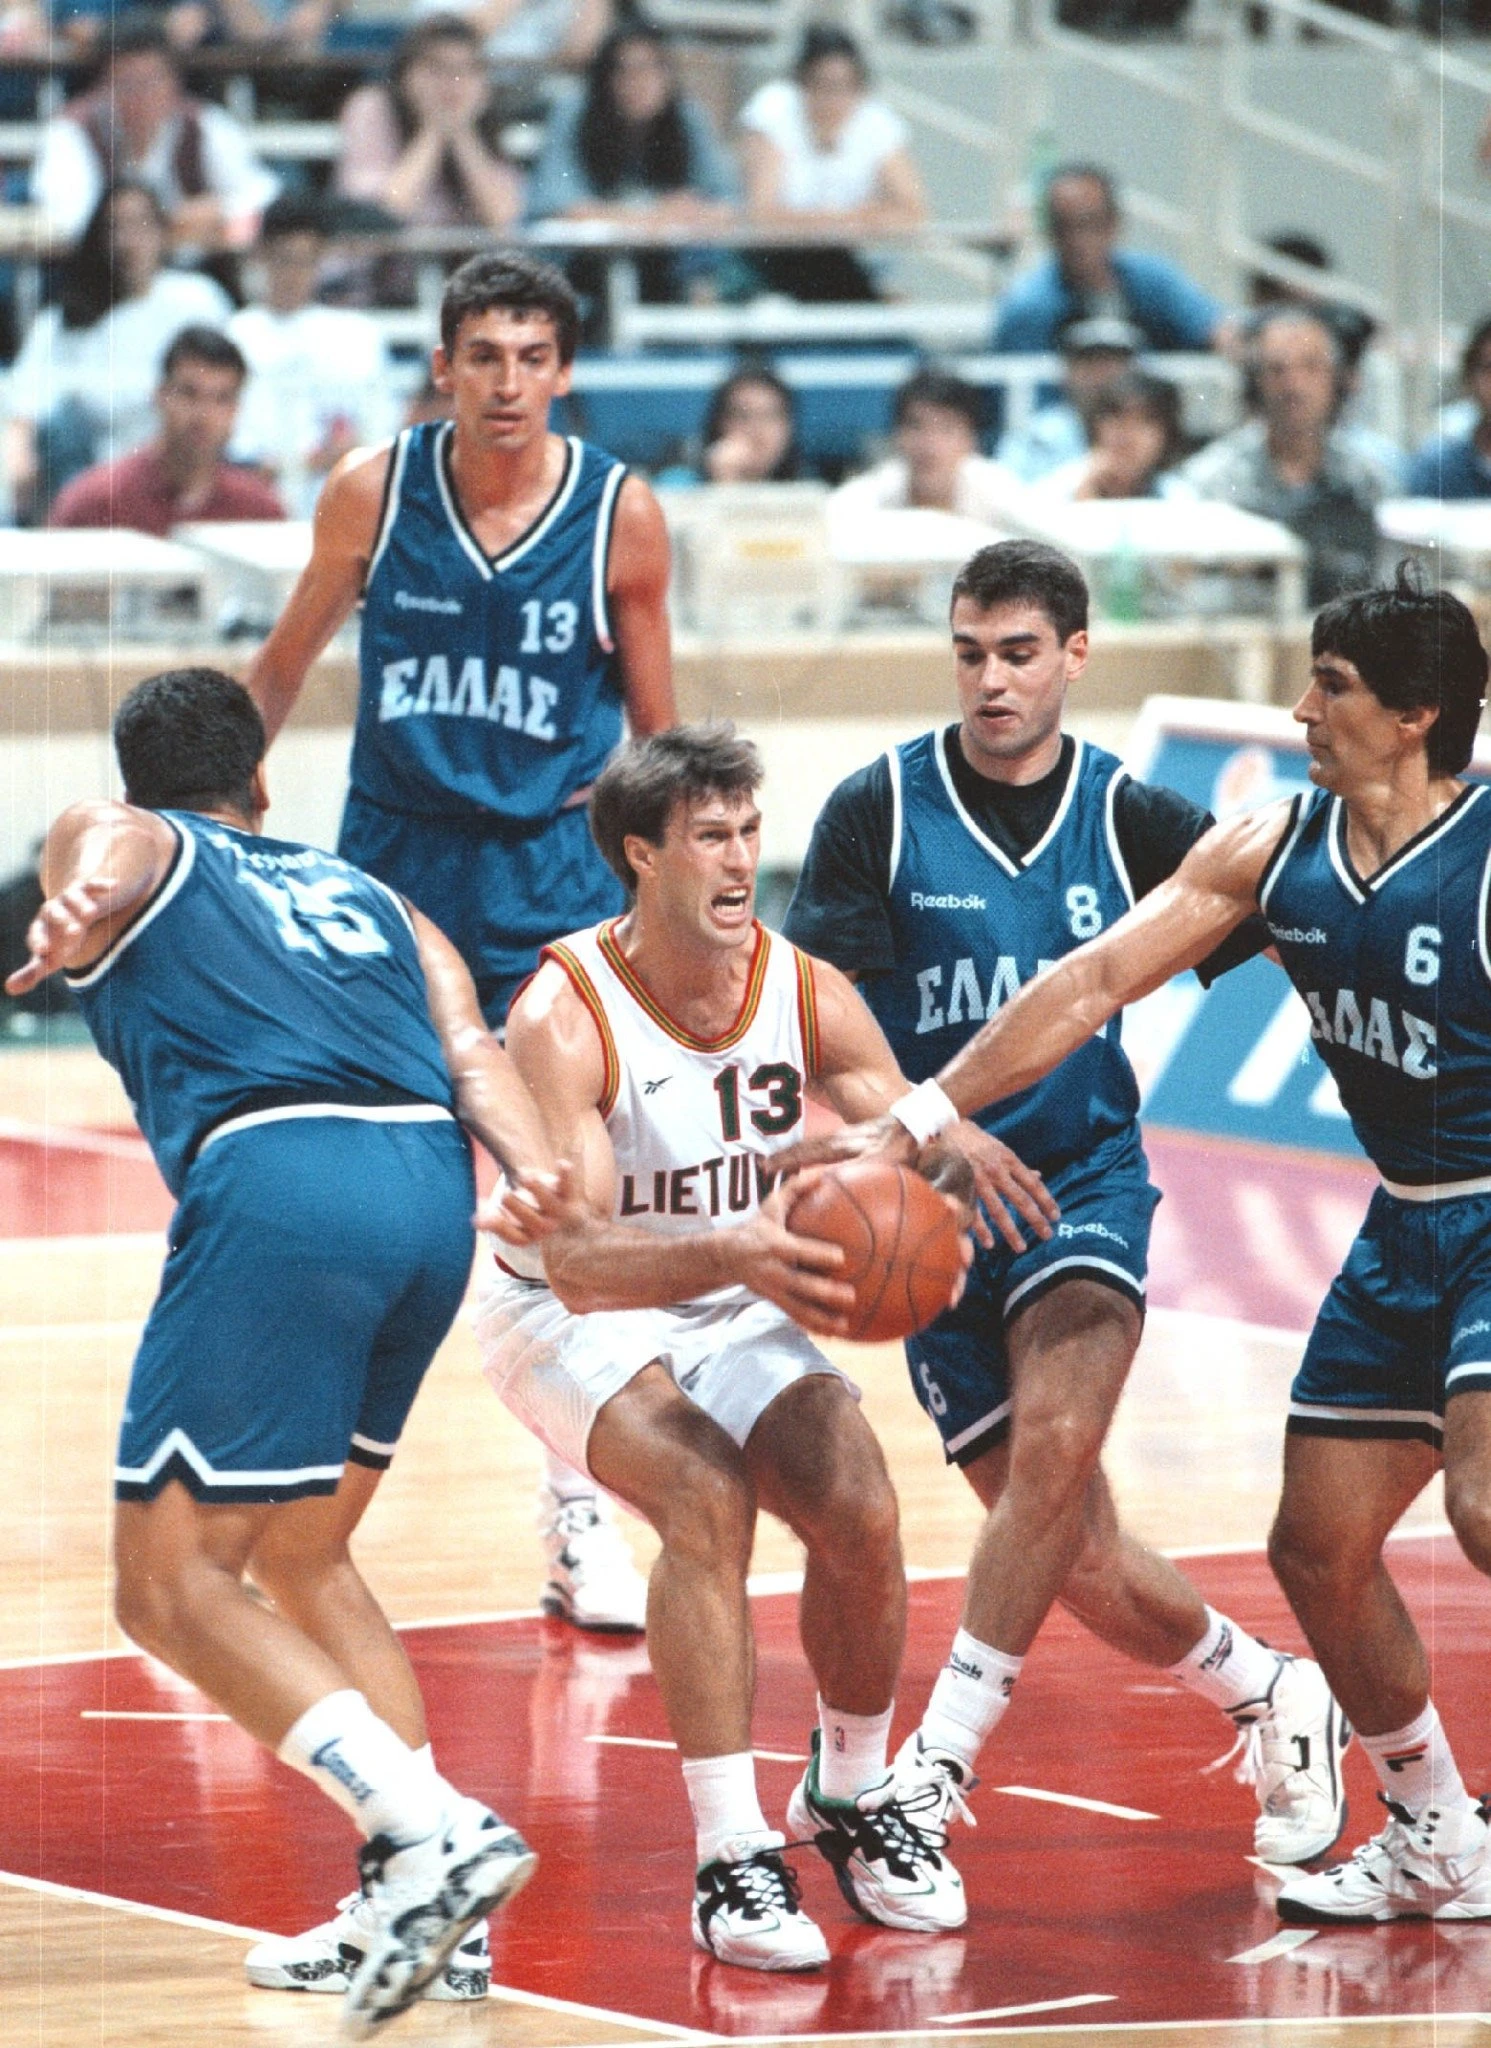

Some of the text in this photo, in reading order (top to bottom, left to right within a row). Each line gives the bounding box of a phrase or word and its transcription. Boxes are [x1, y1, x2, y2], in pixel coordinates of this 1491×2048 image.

[520, 599, 579, 654] 13
[910, 891, 987, 911] Reebok
[1065, 884, 1102, 939] 8
[1404, 924, 1443, 986] 6
[914, 955, 1107, 1039] ΕΛΛ
[713, 1061, 803, 1142] 13
[620, 1151, 789, 1217] LIETUV
